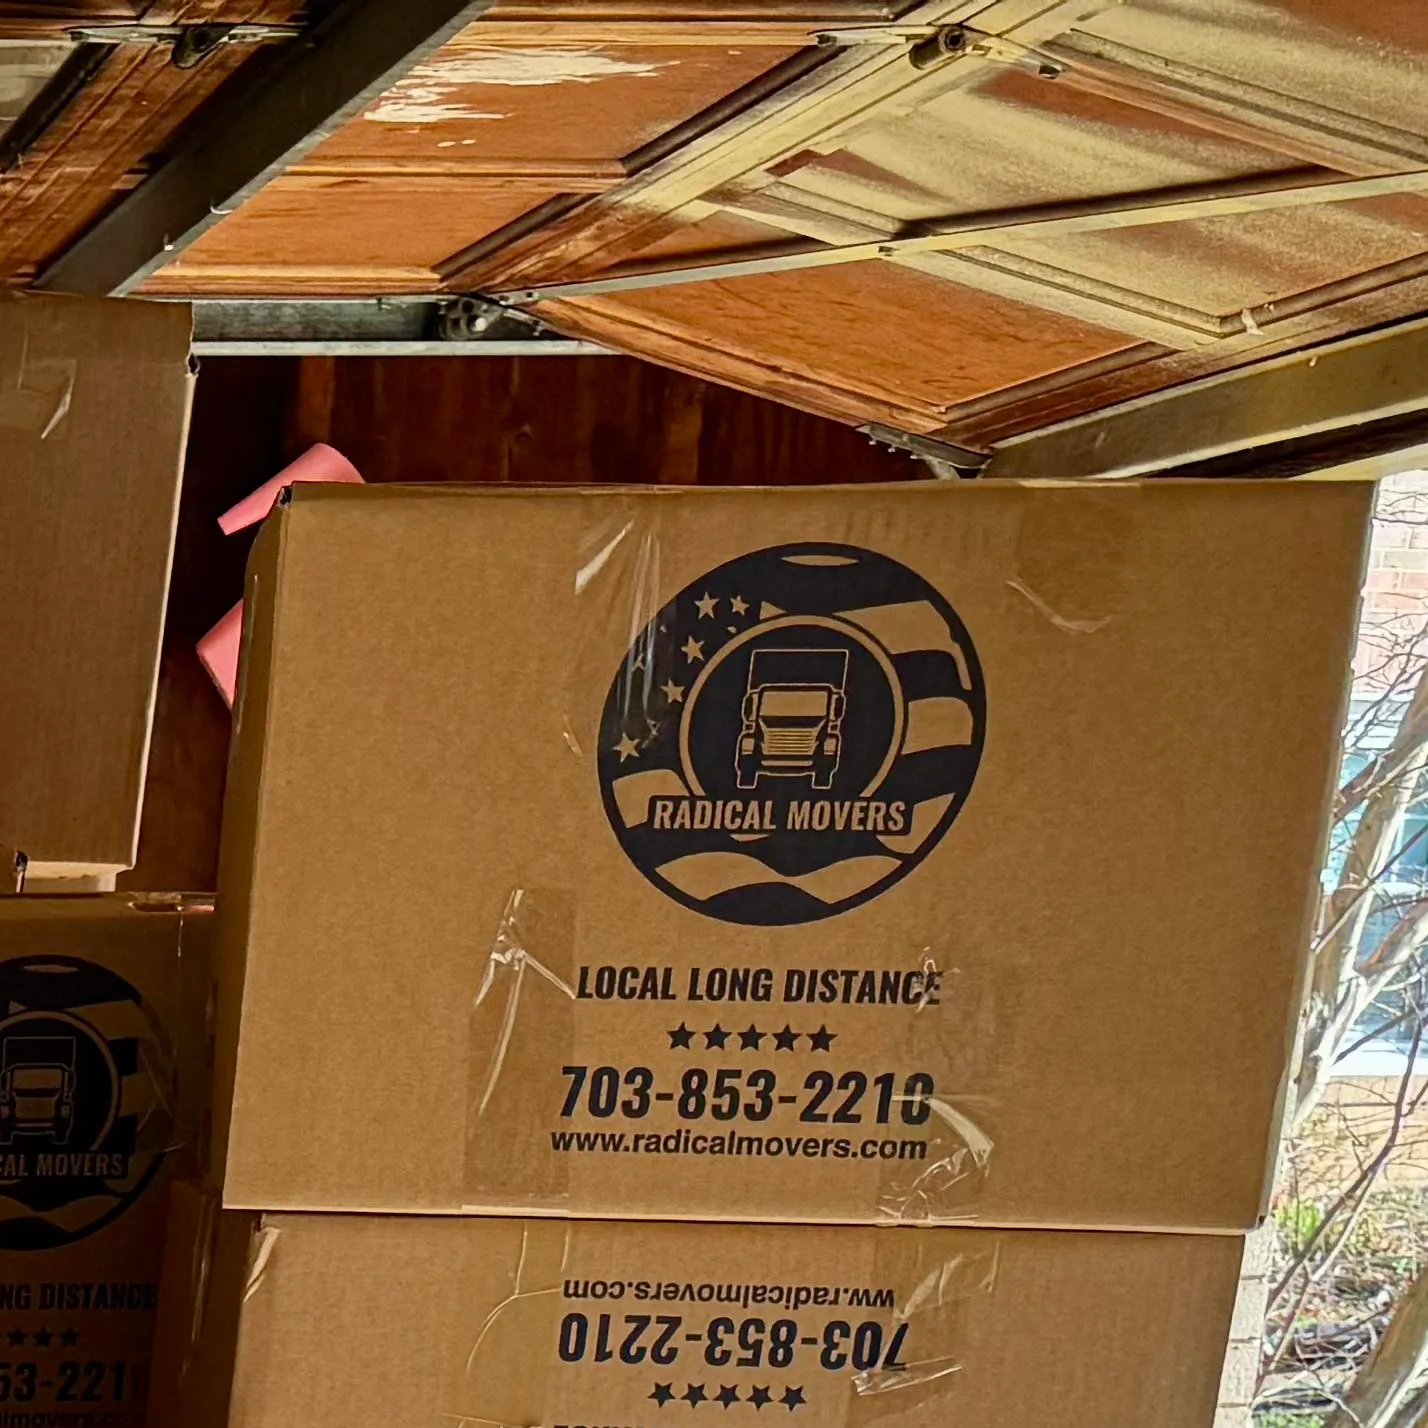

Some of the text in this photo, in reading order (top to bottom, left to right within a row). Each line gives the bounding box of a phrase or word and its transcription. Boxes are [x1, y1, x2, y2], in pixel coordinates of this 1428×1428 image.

[653, 798, 907, 832] RADICAL MOVERS
[577, 965, 944, 1005] LOCAL LONG DISTANCE
[560, 1065, 935, 1125] 703-853-2210
[550, 1129, 927, 1161] www.radicalmovers.com
[36, 1152, 123, 1176] MOVERS
[563, 1279, 895, 1308] ww.radicalmovers.com
[558, 1312, 909, 1370] 703-853-2210
